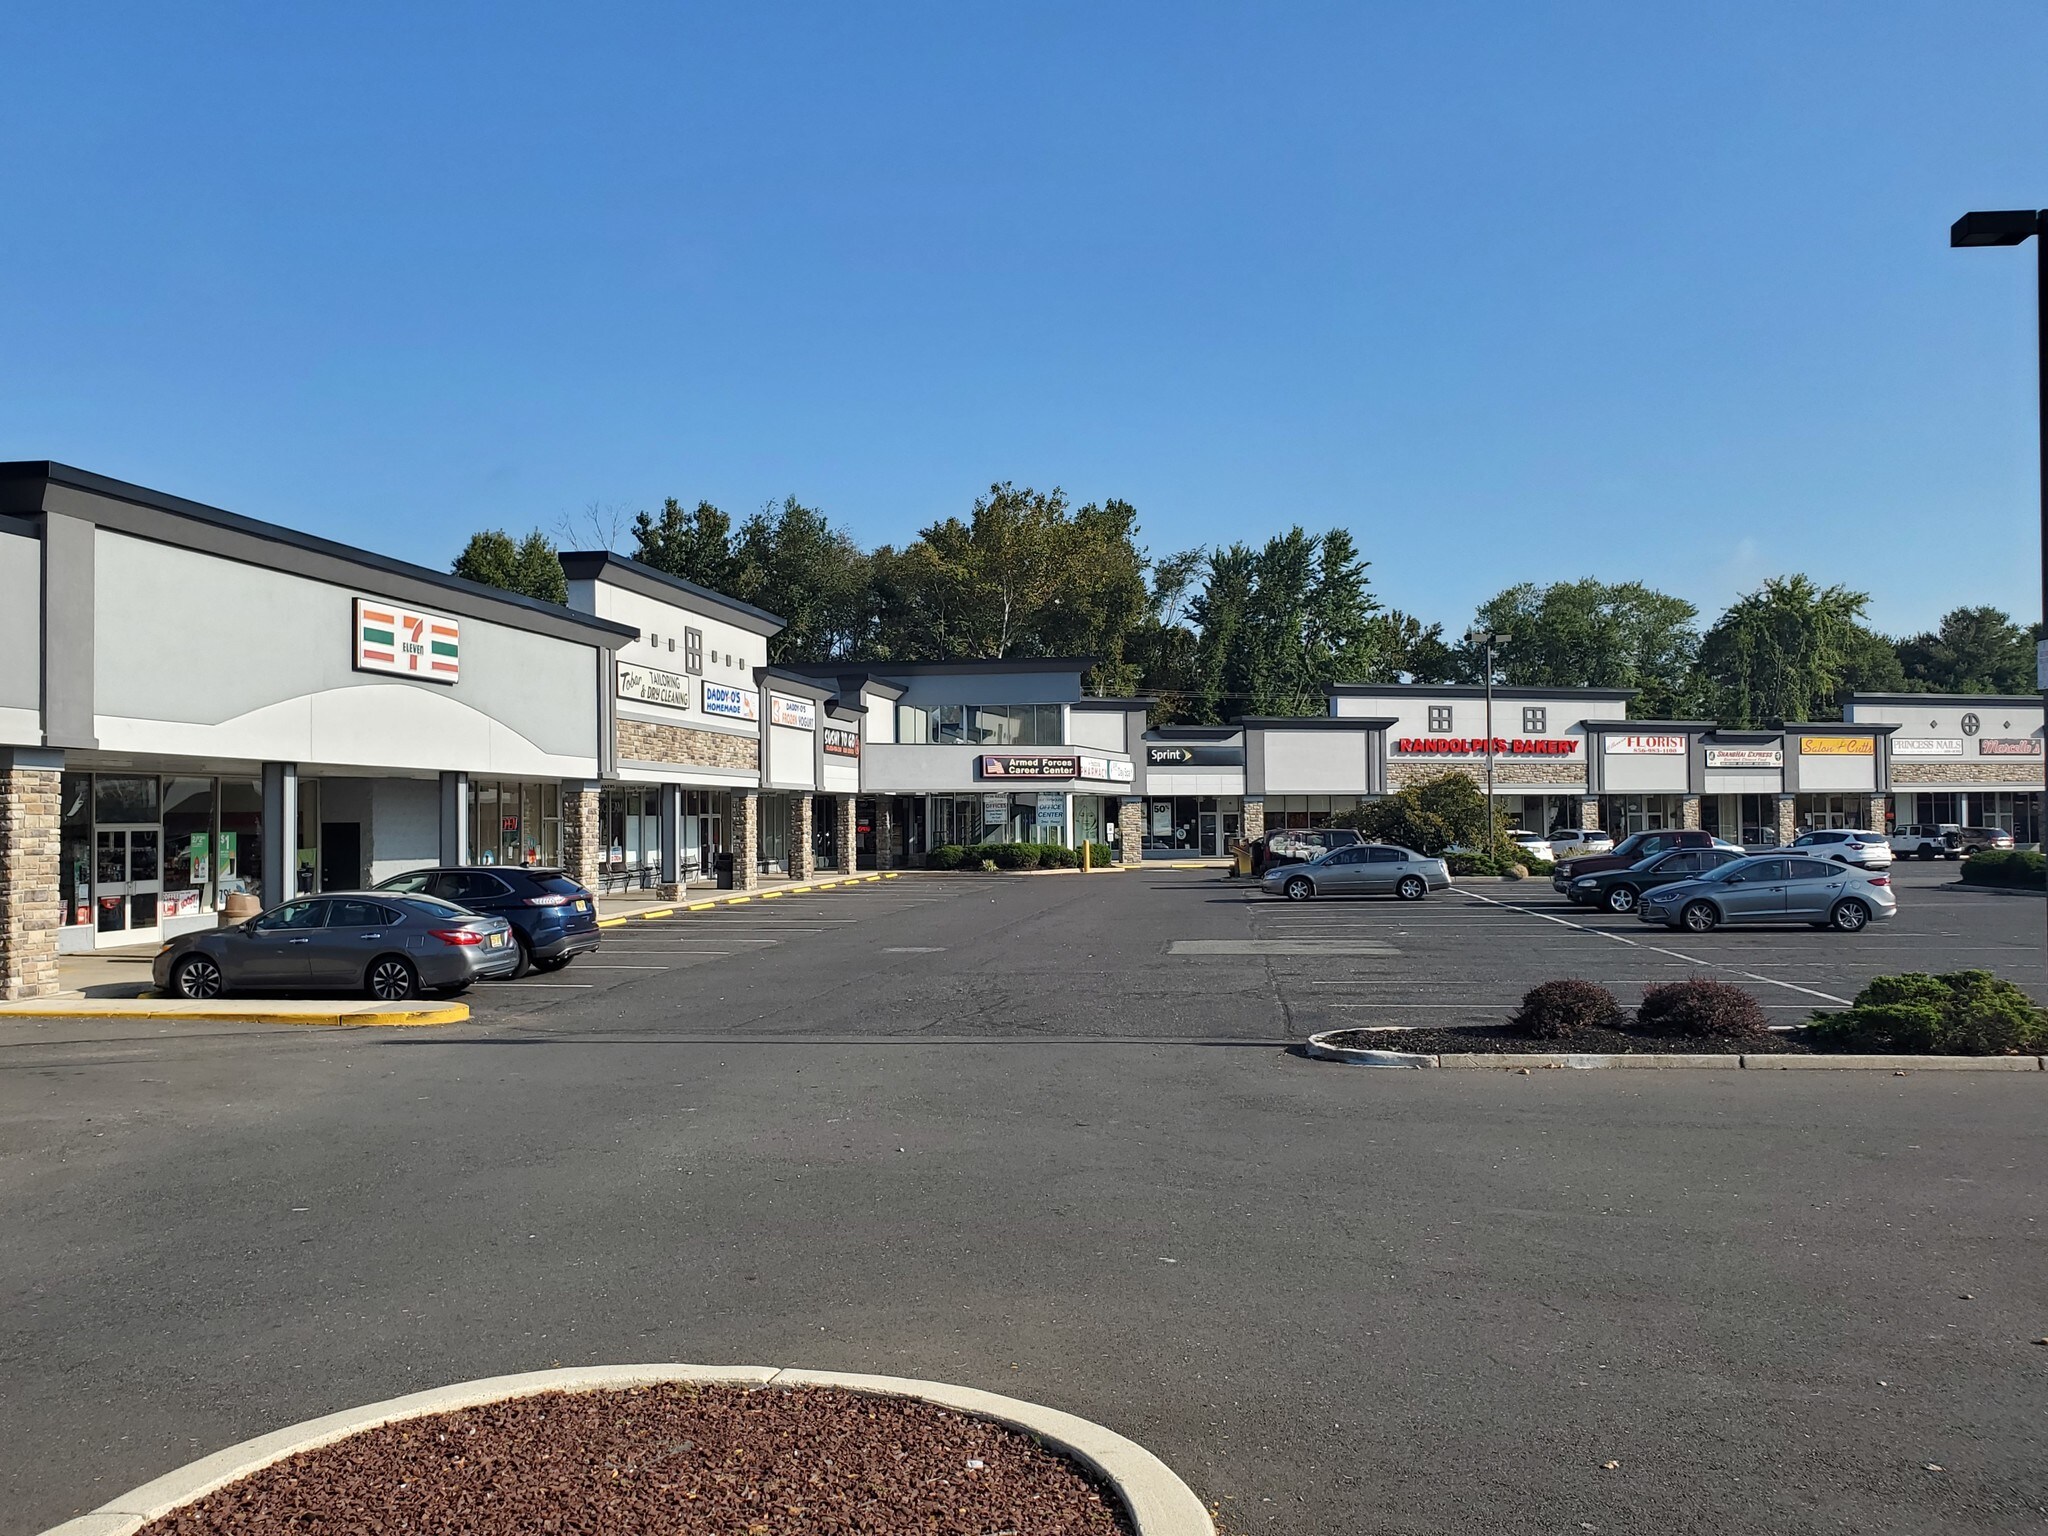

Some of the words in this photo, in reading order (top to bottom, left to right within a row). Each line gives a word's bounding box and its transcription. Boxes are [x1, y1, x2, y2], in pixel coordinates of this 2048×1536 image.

[649, 671, 681, 690] TAILORING
[647, 686, 661, 701] DRY
[661, 688, 688, 706] CLEANING
[706, 702, 741, 714] HOMEMADE
[798, 715, 814, 729] YOGURT
[1511, 739, 1579, 755] BAKERY
[1627, 735, 1686, 748] FLORIST
[1803, 739, 1834, 753] Salon
[1893, 740, 1934, 749] PRINCESS
[1936, 740, 1961, 750] NAILS
[1009, 758, 1039, 767] Armed
[1042, 758, 1073, 767] Forces
[1151, 749, 1181, 763] Sprint
[1008, 766, 1039, 774] Career
[1042, 766, 1074, 774] Center
